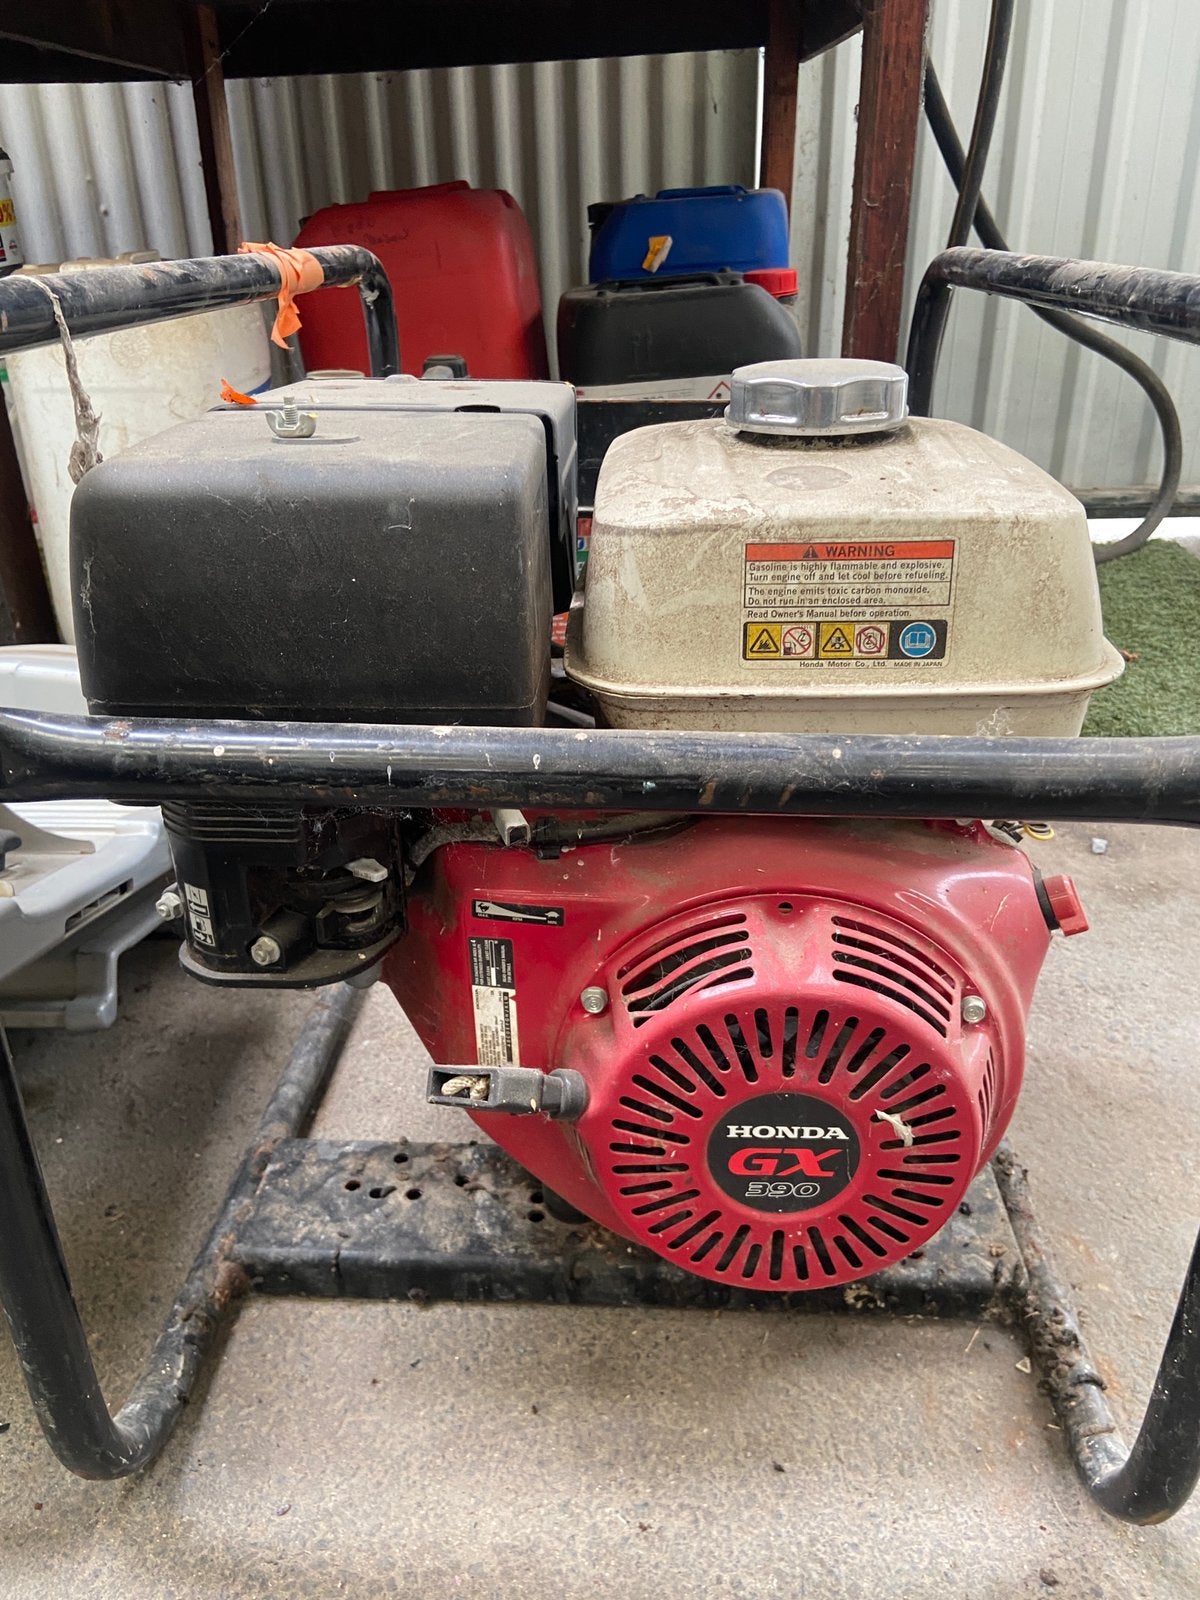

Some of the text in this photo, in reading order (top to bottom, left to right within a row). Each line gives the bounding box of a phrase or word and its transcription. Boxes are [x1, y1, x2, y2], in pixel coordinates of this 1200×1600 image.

[826, 545, 896, 558] WARNING
[750, 560, 945, 574] Gasoline is highly flammable and explosive.
[750, 570, 948, 582] Turn engine off and let cool before refueling.
[748, 584, 930, 597] The engine emits toxic carbon monoxide.
[748, 598, 760, 606] Do
[762, 598, 776, 606] not
[796, 596, 804, 605] in
[822, 596, 861, 605] enclosed
[747, 608, 912, 619] Read Owner's Manual before operation.
[726, 1126, 850, 1140] HONDA
[728, 1148, 844, 1177] GX
[745, 1182, 820, 1198] 390
